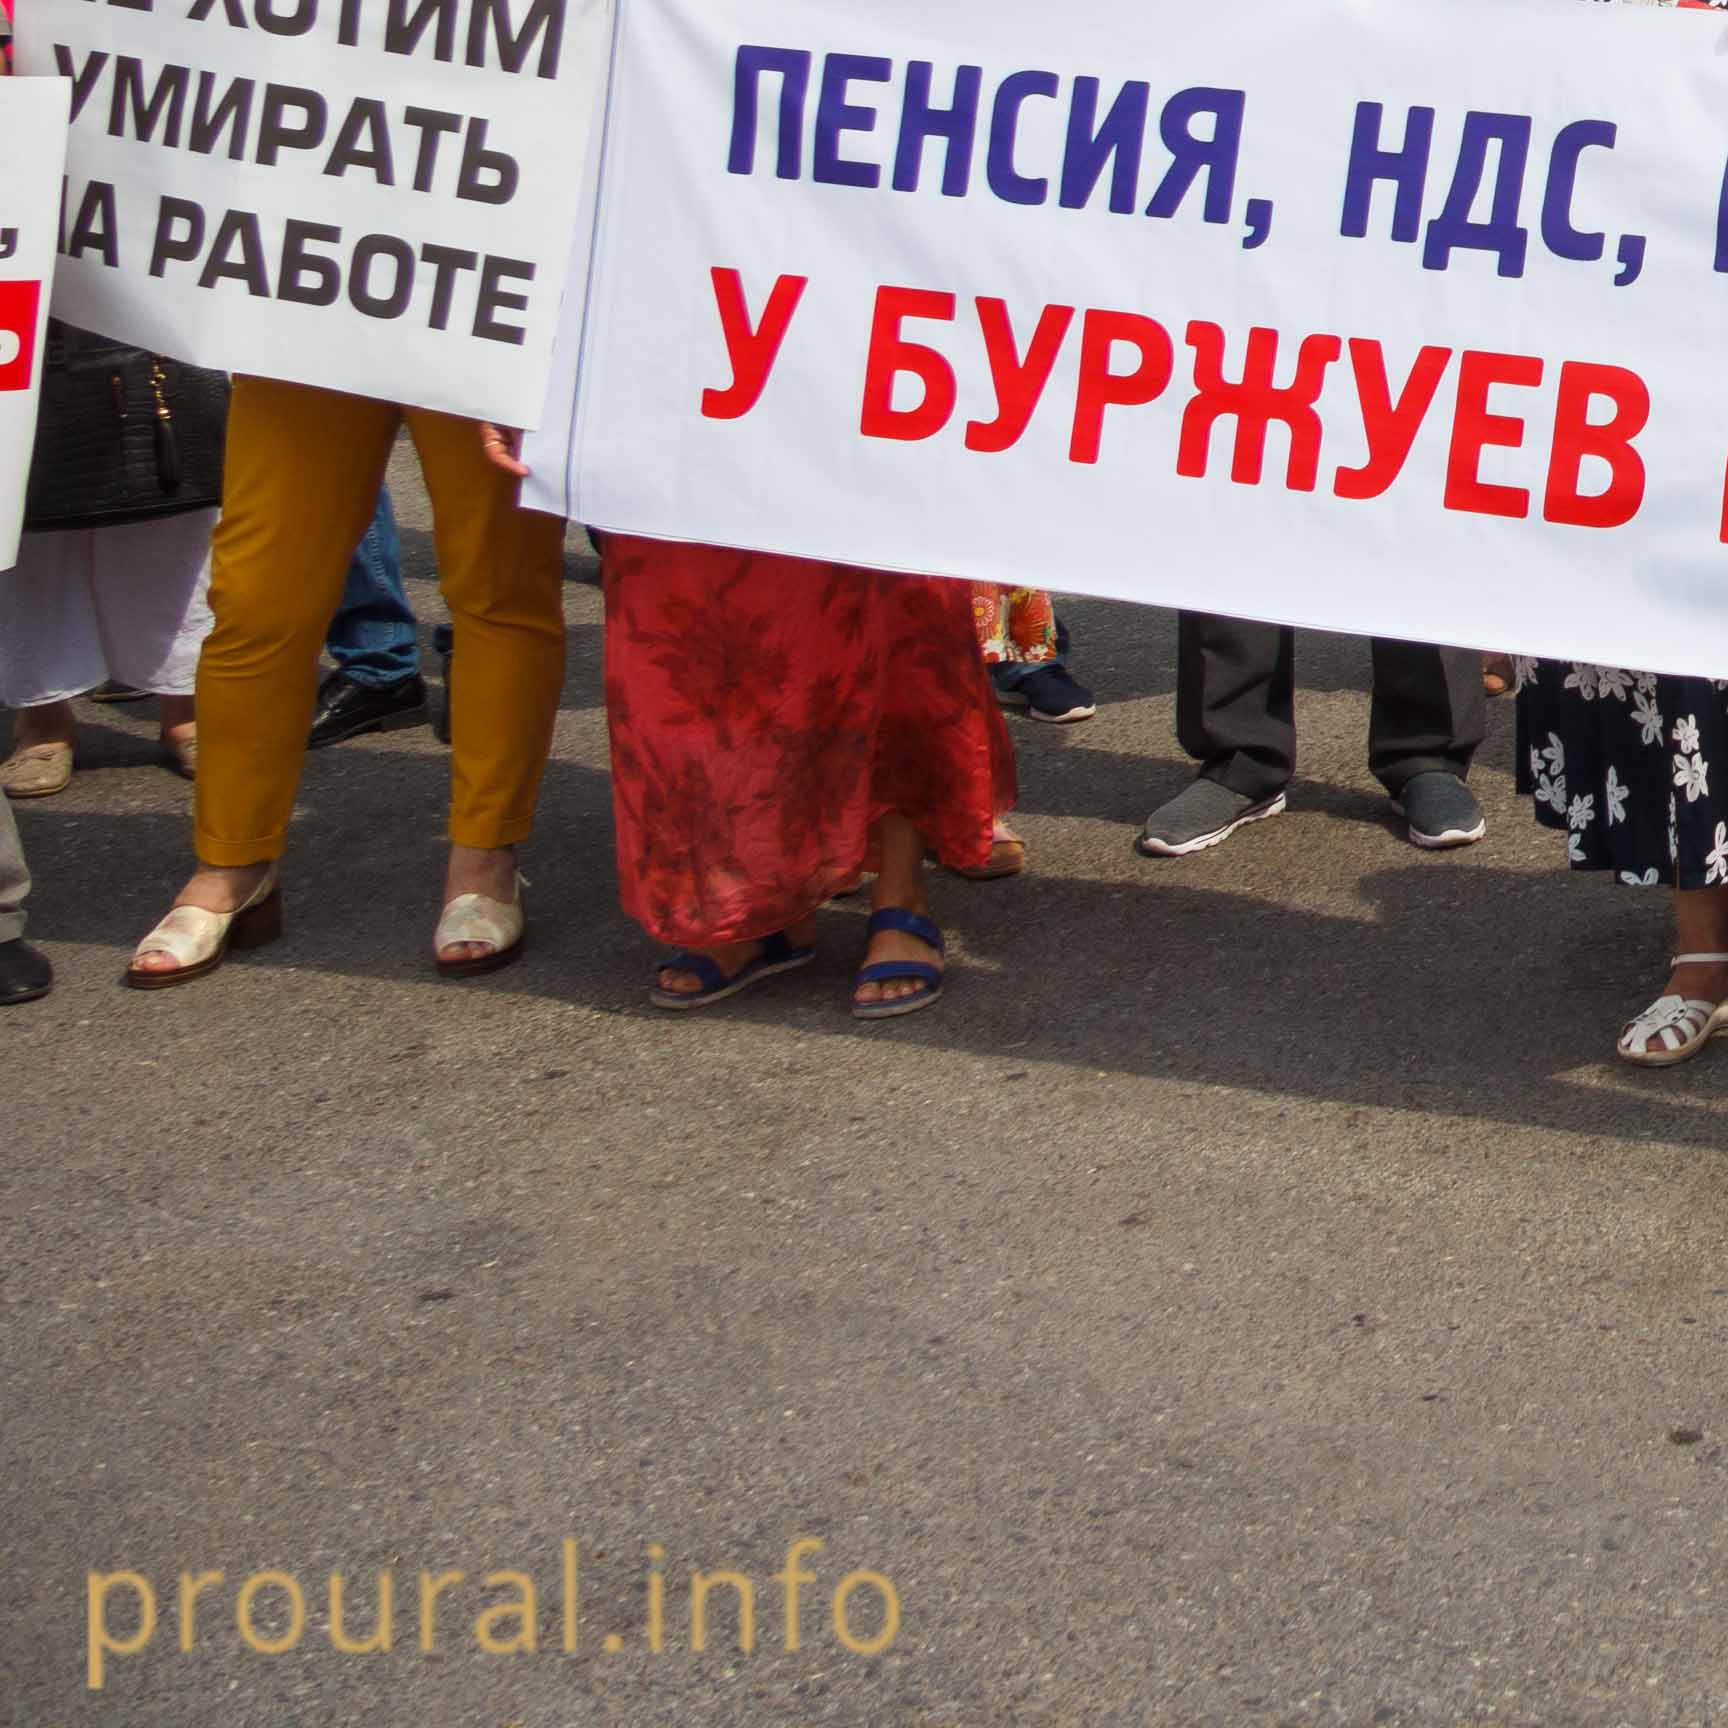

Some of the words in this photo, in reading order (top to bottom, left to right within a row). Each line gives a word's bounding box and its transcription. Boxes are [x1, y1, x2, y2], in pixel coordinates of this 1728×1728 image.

[54, 43, 520, 205] УМИРАТЬ
[727, 44, 1273, 250] ПЕНСИЯ,
[1339, 101, 1646, 287] НДС,
[148, 195, 536, 346] РАБОТЕ
[700, 266, 807, 420] У
[859, 285, 1650, 529] БУРЖУЕВ
